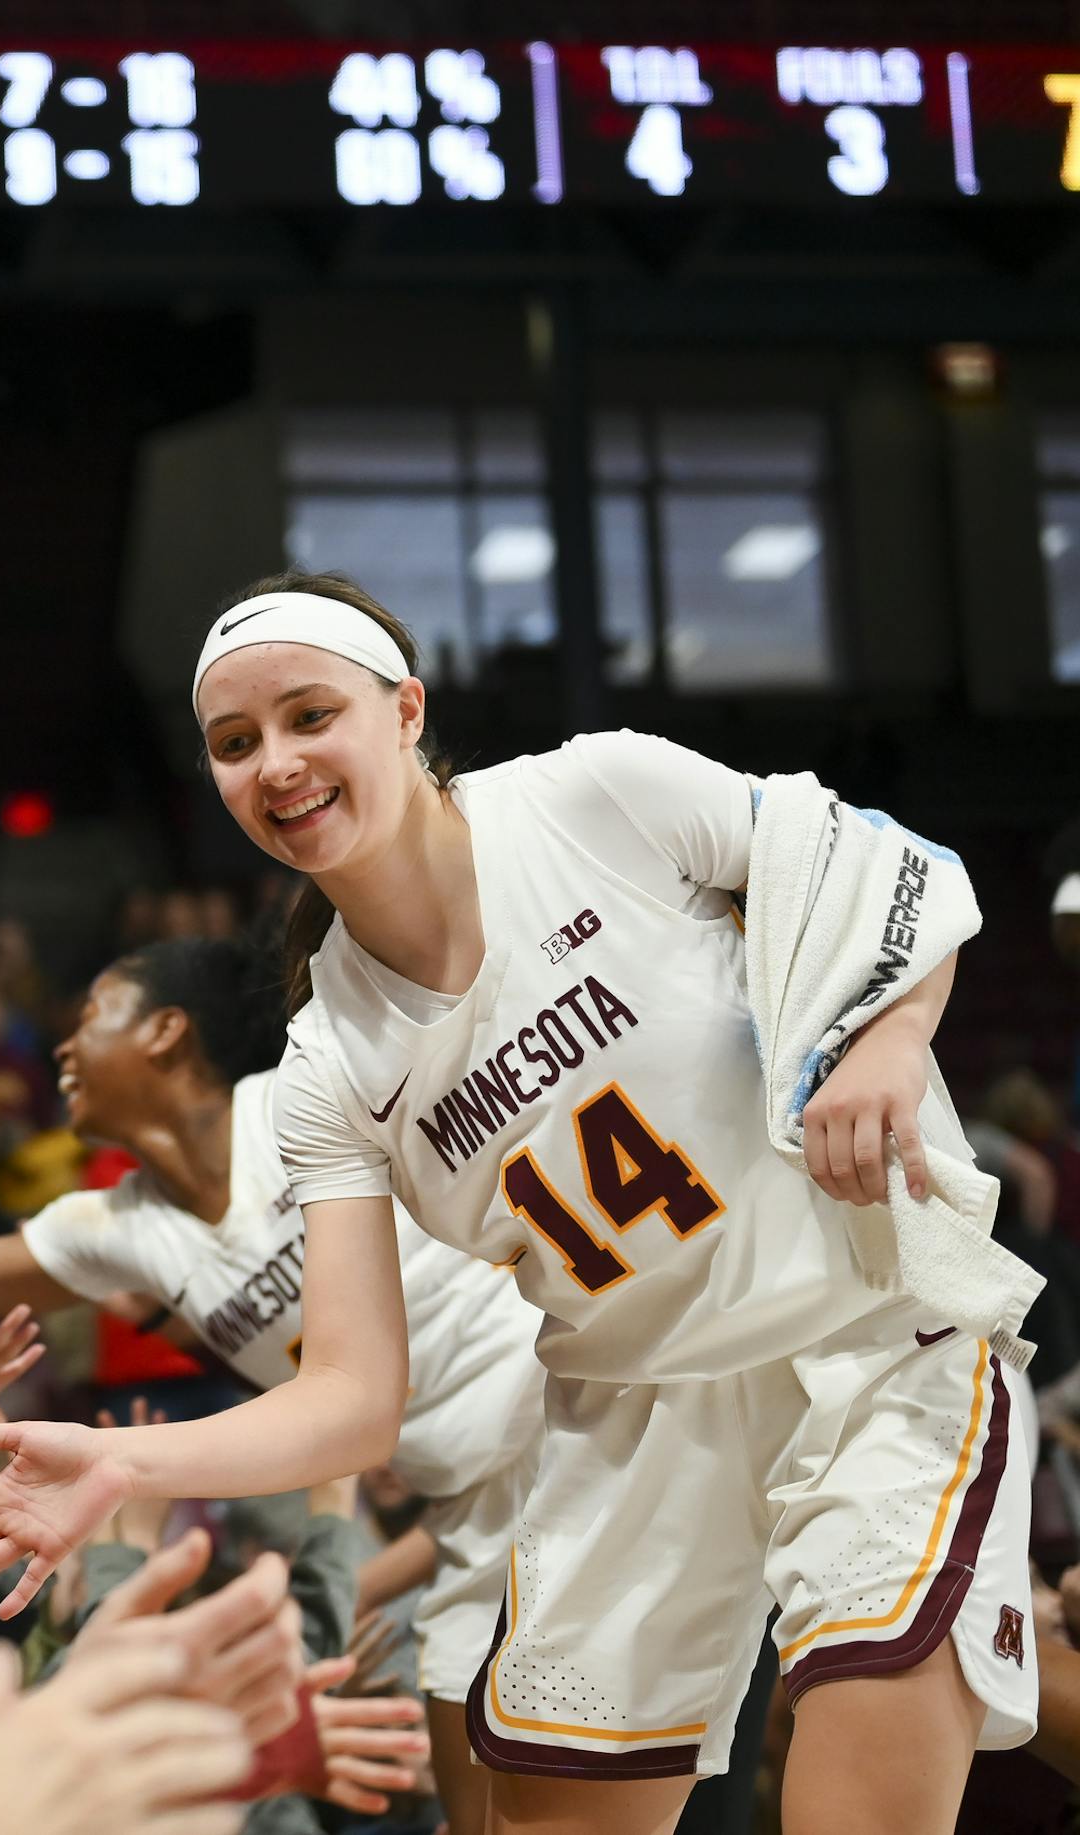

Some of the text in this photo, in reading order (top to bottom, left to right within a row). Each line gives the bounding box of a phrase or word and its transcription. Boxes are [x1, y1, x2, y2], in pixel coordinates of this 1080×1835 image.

[626, 104, 692, 195] 4
[825, 105, 888, 195] 3
[416, 975, 639, 1174] MINNESOTA
[501, 1080, 727, 1297] 14
